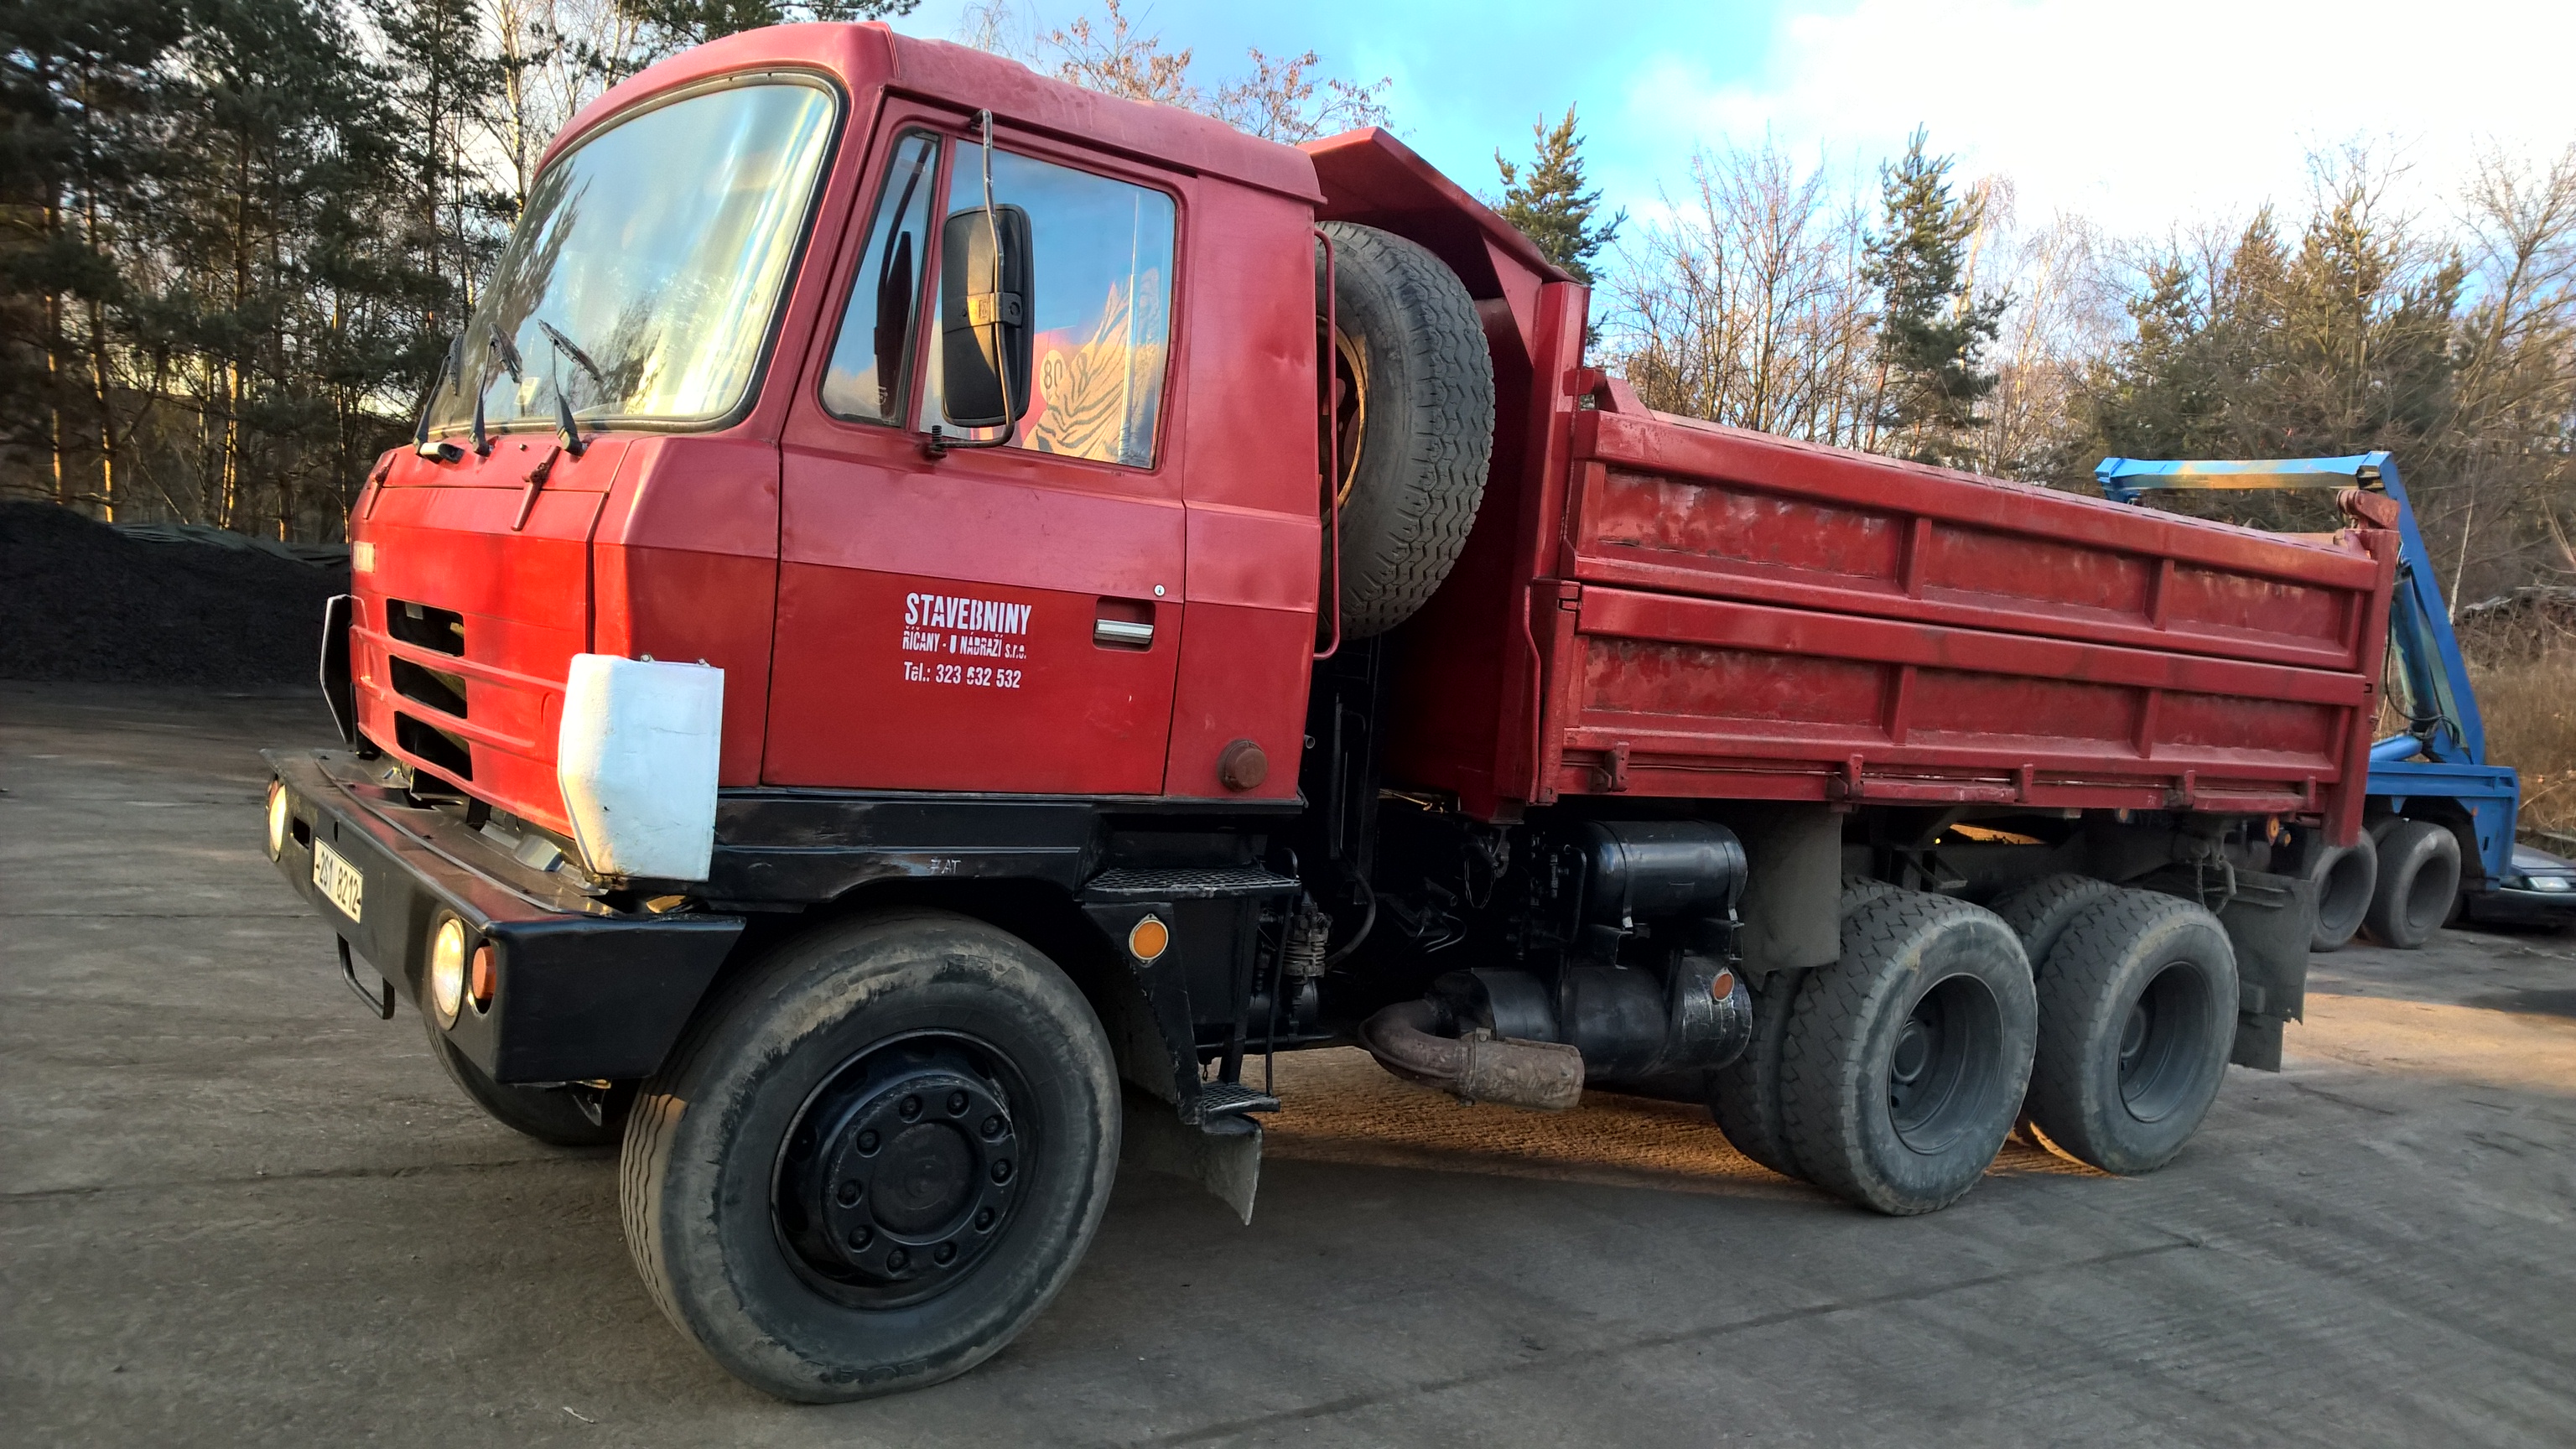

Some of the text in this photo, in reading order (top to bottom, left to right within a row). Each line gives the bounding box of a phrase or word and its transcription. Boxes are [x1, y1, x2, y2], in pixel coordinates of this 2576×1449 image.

[904, 592, 1032, 636] STAVEBNINY
[902, 626, 941, 652] ŘÍČANY
[959, 631, 1004, 658] NÁDRAŽÍ
[1004, 642, 1027, 660] s.r.o.
[903, 661, 1022, 688] Tel.: 323 632 532
[319, 849, 359, 916] 2S1 8212
